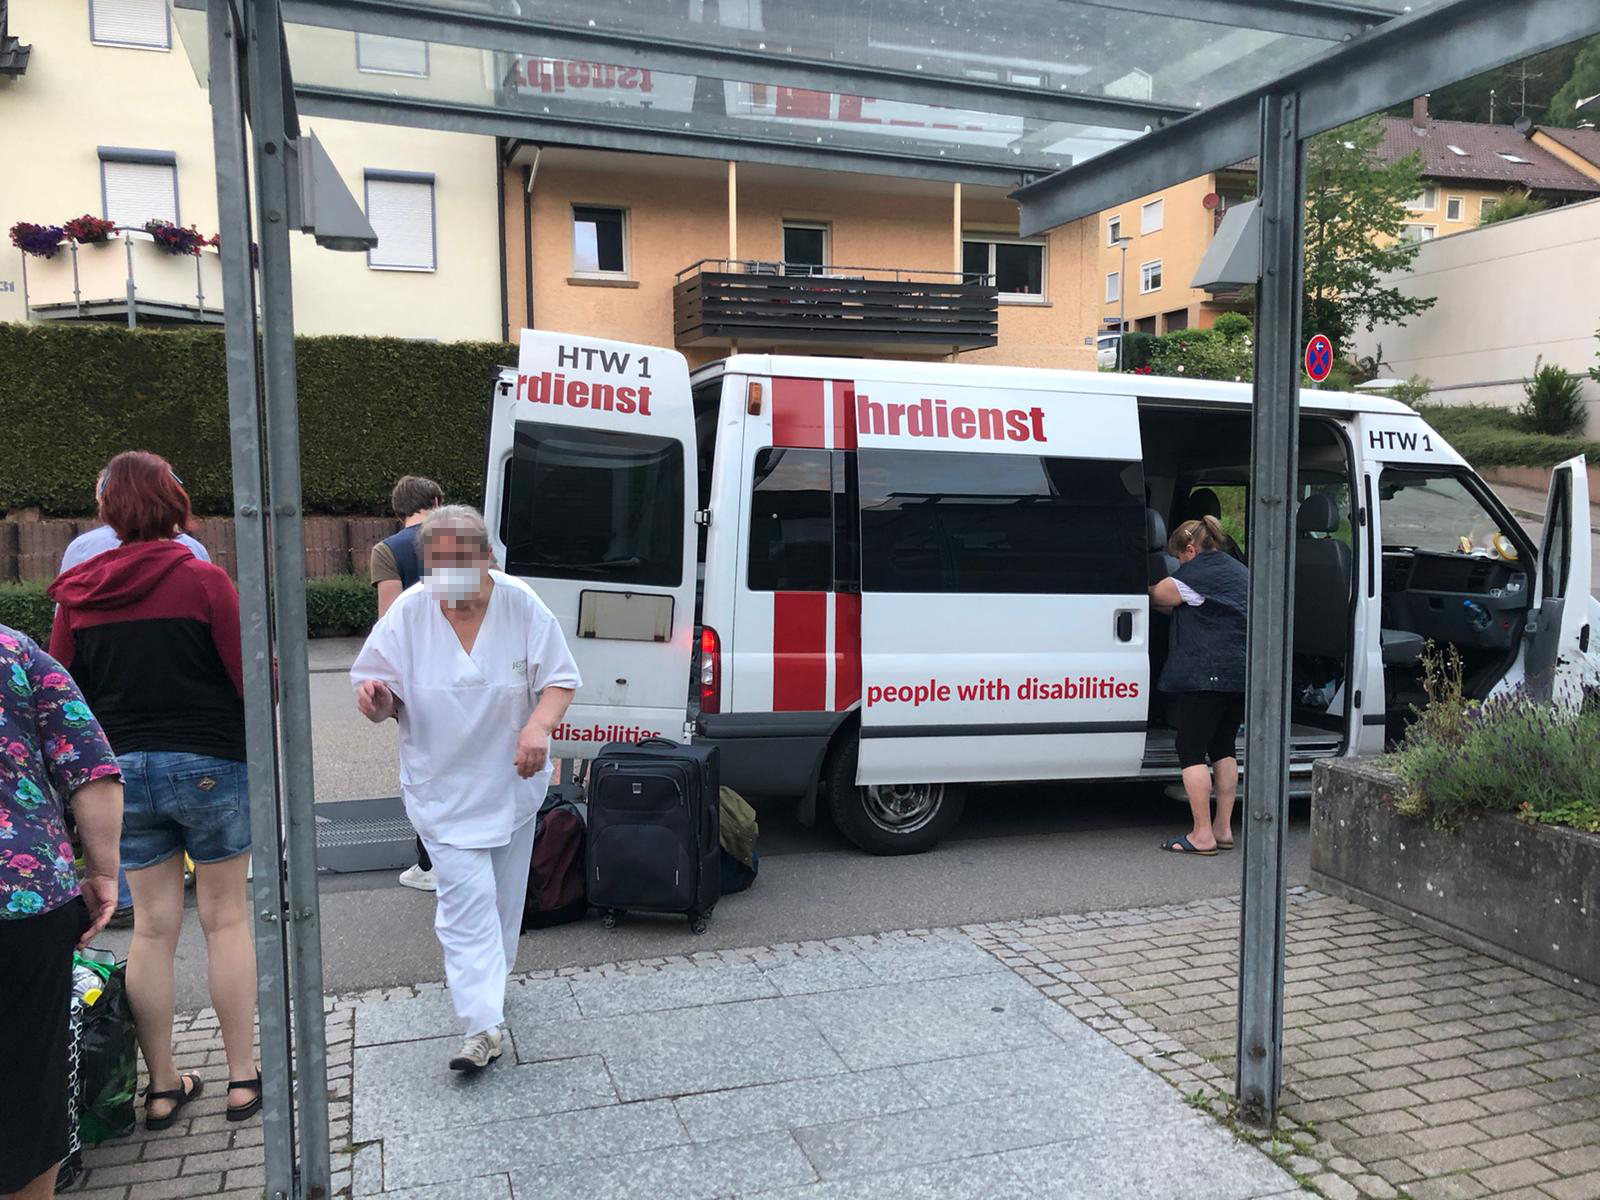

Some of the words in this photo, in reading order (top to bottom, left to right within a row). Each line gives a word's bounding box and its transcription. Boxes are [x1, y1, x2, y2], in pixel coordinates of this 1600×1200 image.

[558, 345, 631, 374] HTW
[638, 356, 651, 379] 1
[516, 371, 652, 416] rdienst
[857, 395, 1047, 442] hrdienst
[1369, 430, 1417, 451] HTW
[1422, 434, 1434, 452] 1
[867, 679, 950, 707] people
[957, 678, 1010, 701] with
[1017, 676, 1139, 700] disabilities
